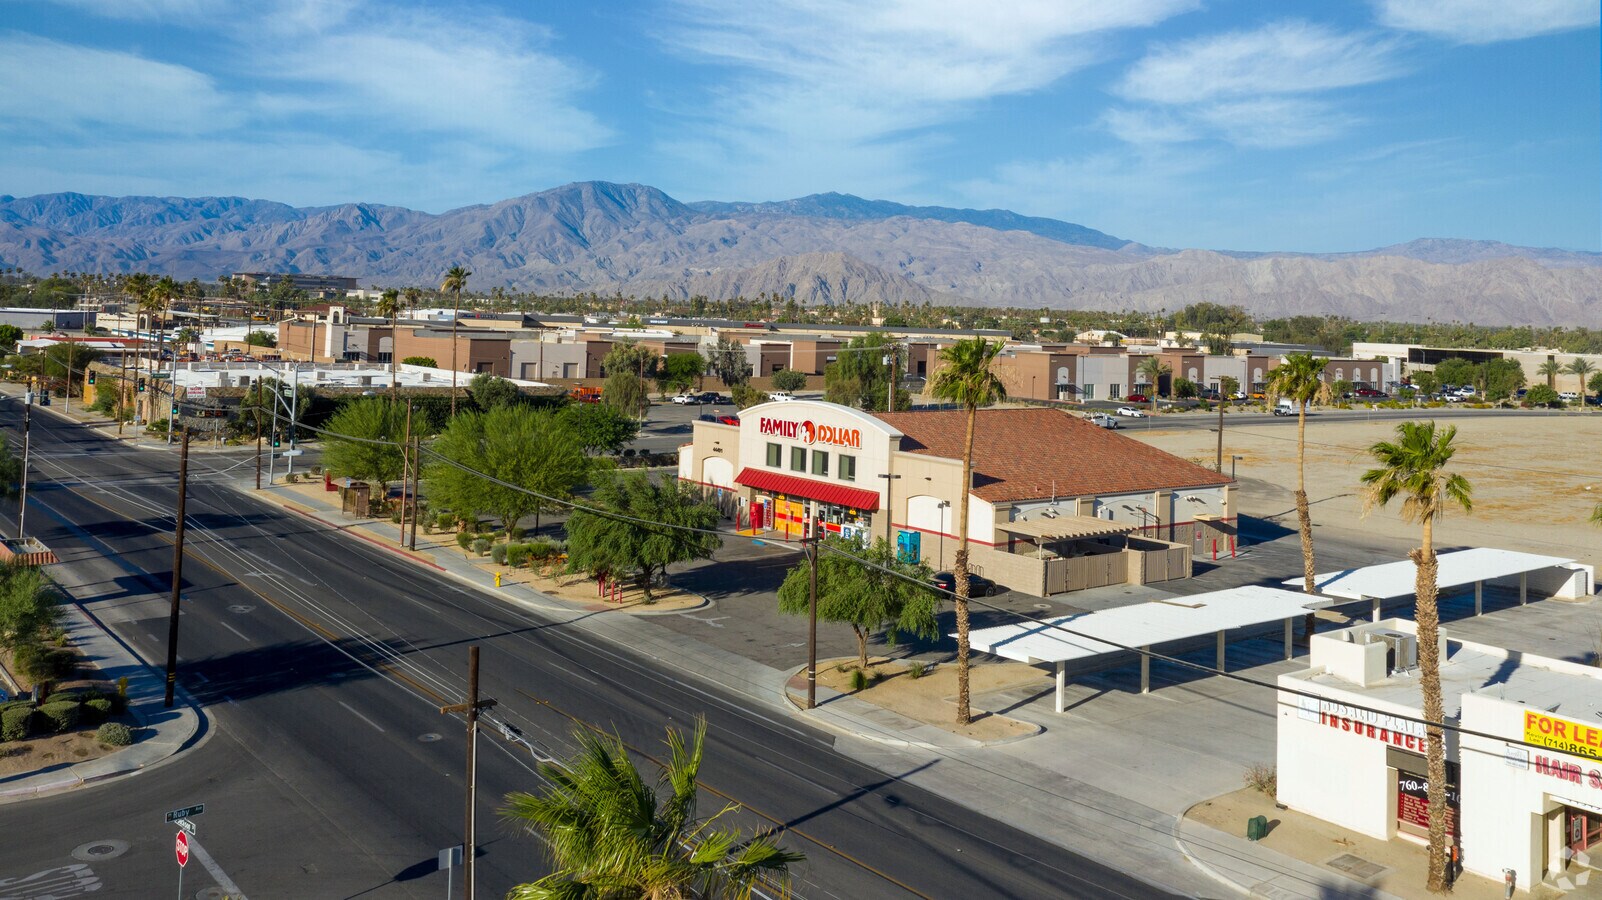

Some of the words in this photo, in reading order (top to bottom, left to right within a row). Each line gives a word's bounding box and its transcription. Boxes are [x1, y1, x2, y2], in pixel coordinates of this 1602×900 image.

[760, 417, 799, 438] FAMILY
[817, 424, 861, 448] DOLLAR
[1321, 711, 1427, 753] INSURANCE
[1526, 713, 1567, 739] FOR
[1573, 725, 1602, 749] LE
[1535, 755, 1582, 785] HAIR
[1588, 769, 1602, 790] S
[176, 839, 188, 857] STOP
